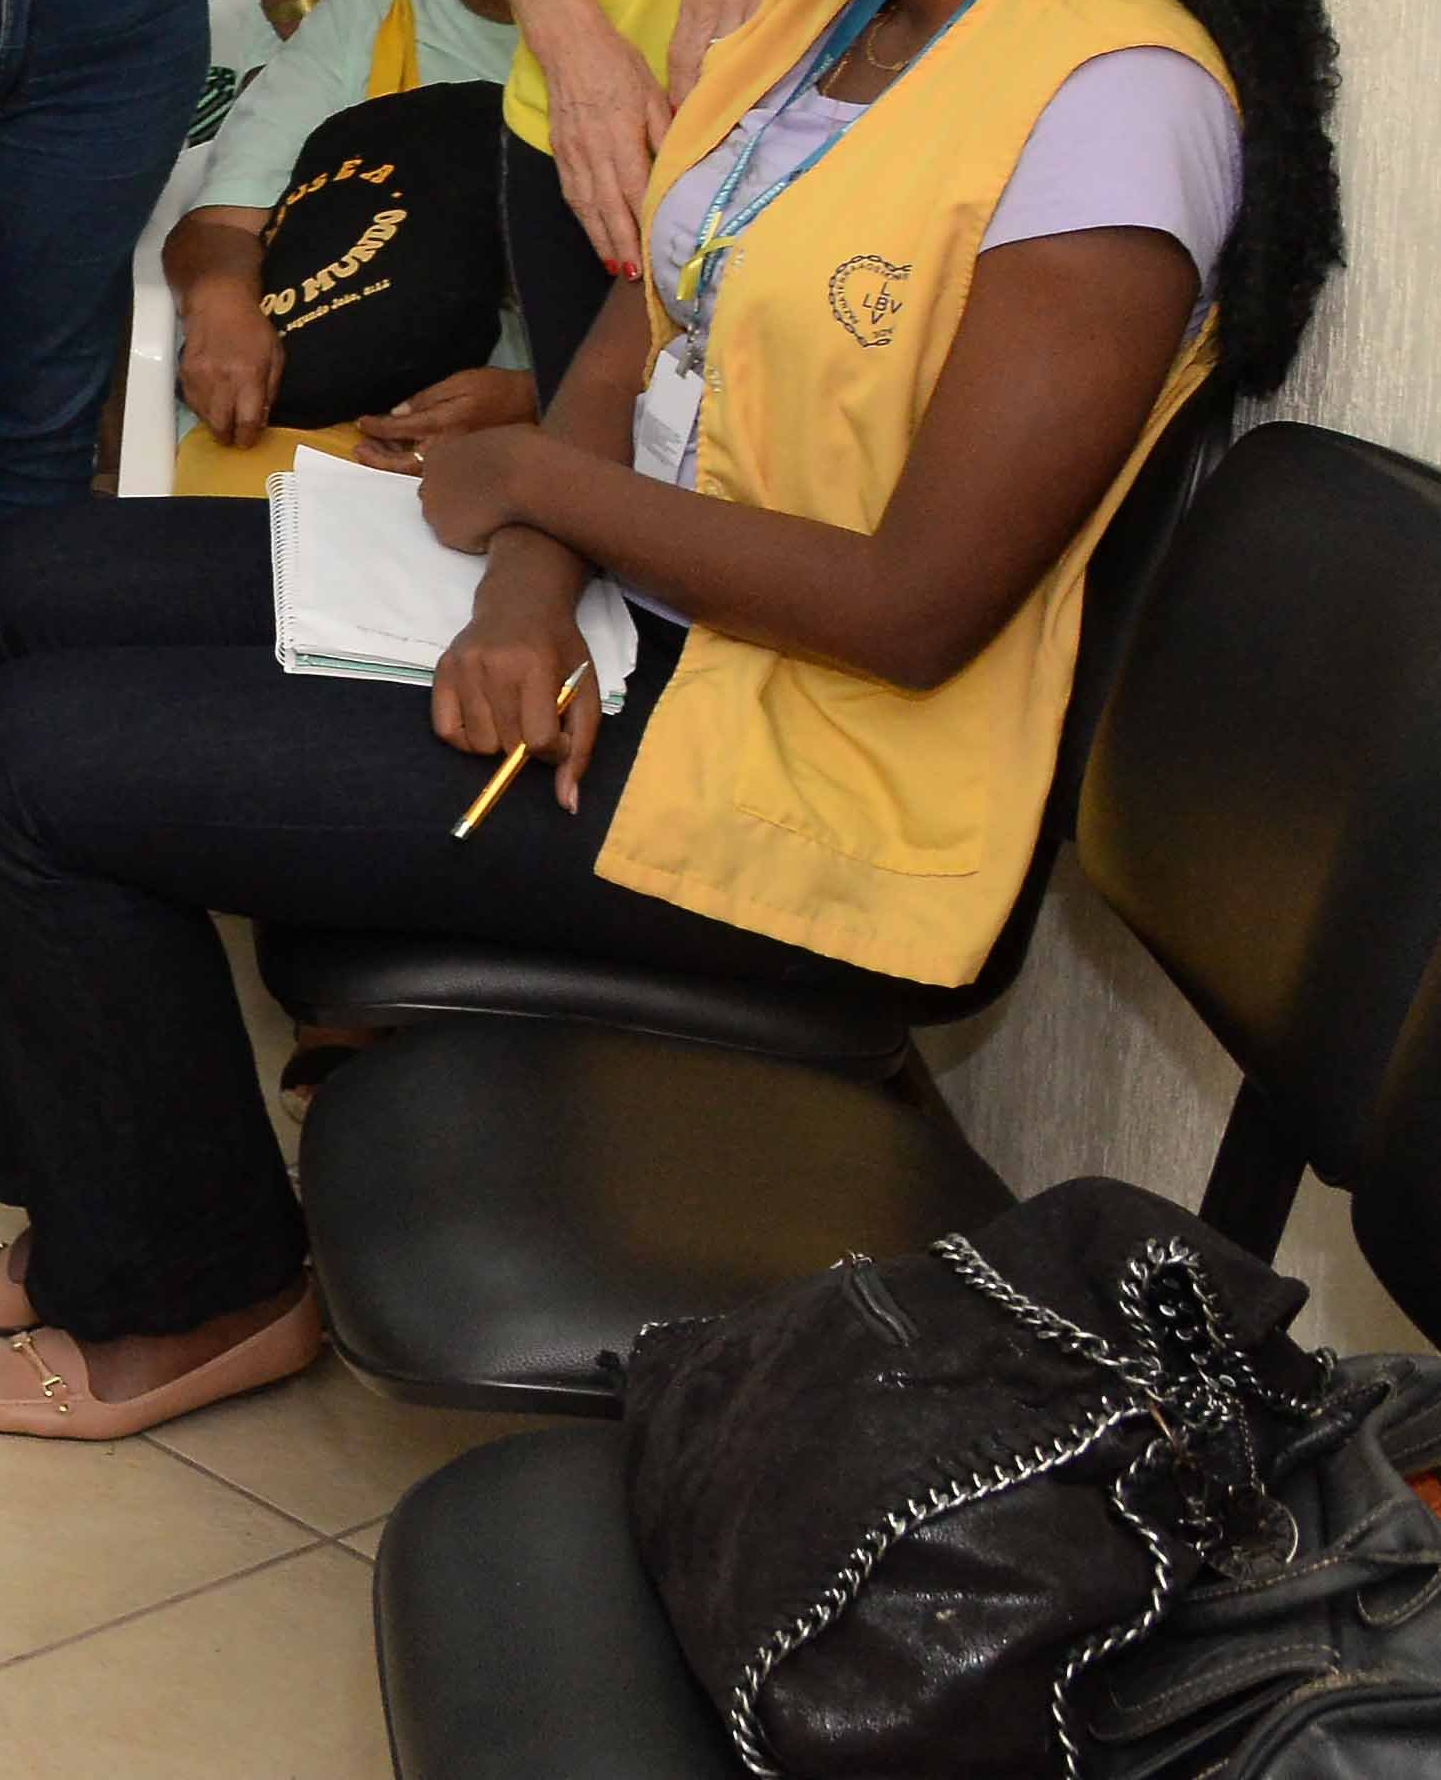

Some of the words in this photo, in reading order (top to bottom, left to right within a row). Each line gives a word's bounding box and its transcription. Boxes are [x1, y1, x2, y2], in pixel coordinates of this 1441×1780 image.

[301, 209, 407, 302] MUNDO
[881, 281, 891, 296] L
[862, 293, 902, 314] LBV
[871, 310, 884, 324] V
